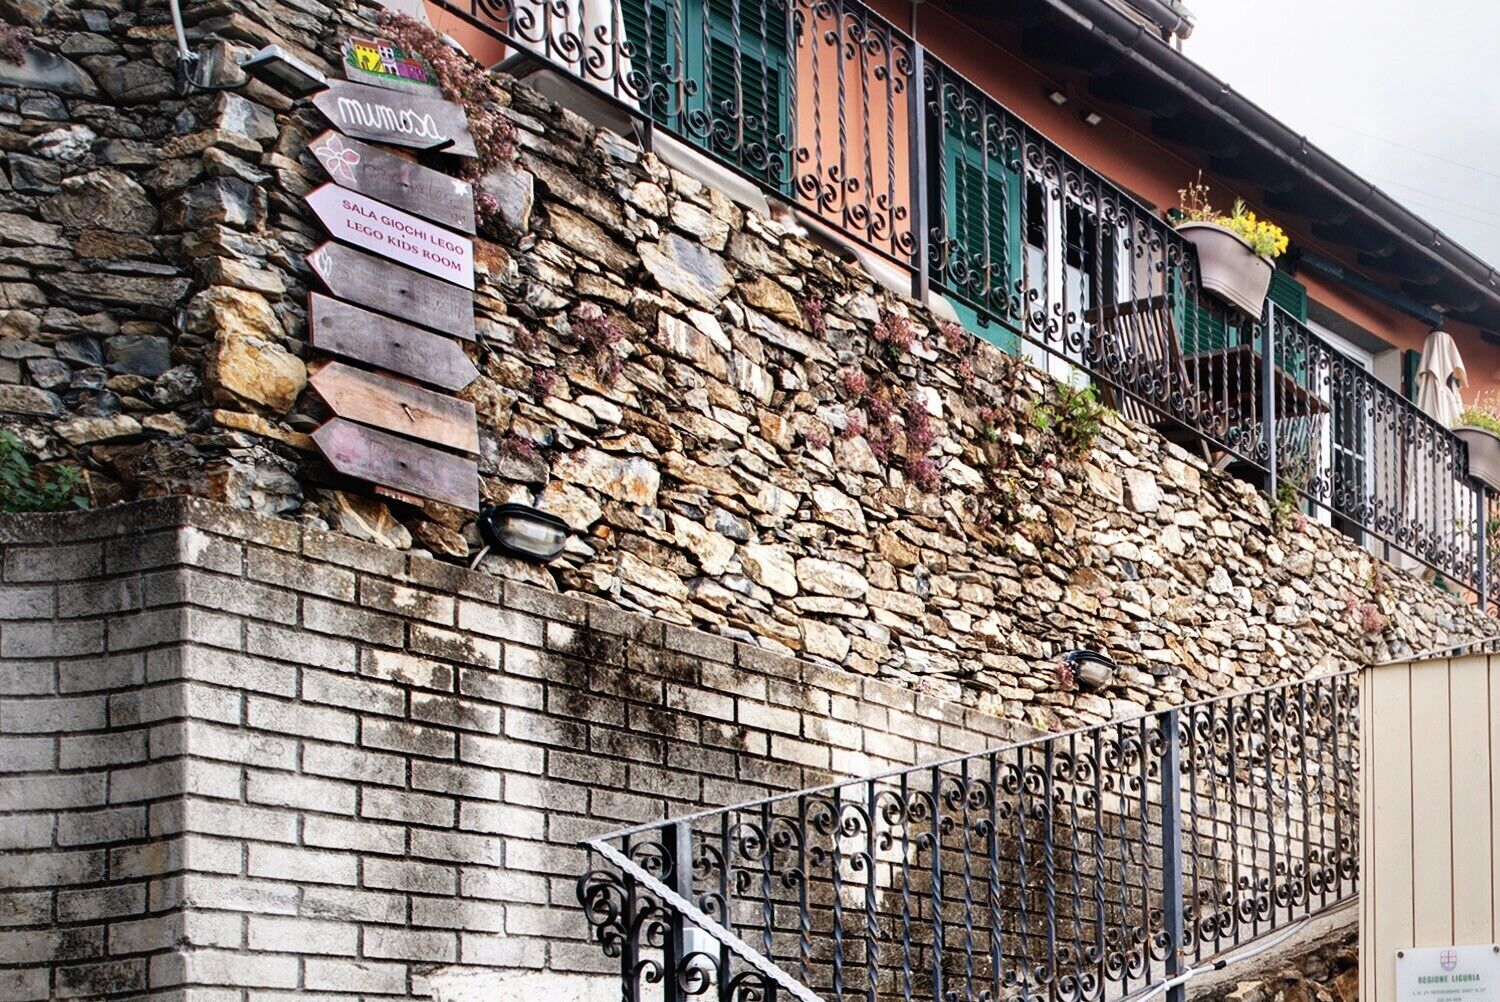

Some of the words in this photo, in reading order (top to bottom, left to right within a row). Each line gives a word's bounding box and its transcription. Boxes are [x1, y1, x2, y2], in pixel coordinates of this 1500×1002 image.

[342, 199, 378, 221] SALA
[381, 215, 428, 241] GIOCHI
[430, 234, 464, 256] LEGO
[346, 219, 384, 240] LEGO
[387, 235, 419, 255] KIDS
[422, 249, 462, 272] ROOM
[1417, 975, 1448, 984] REGIONE
[1451, 973, 1481, 983] LIGURIA
